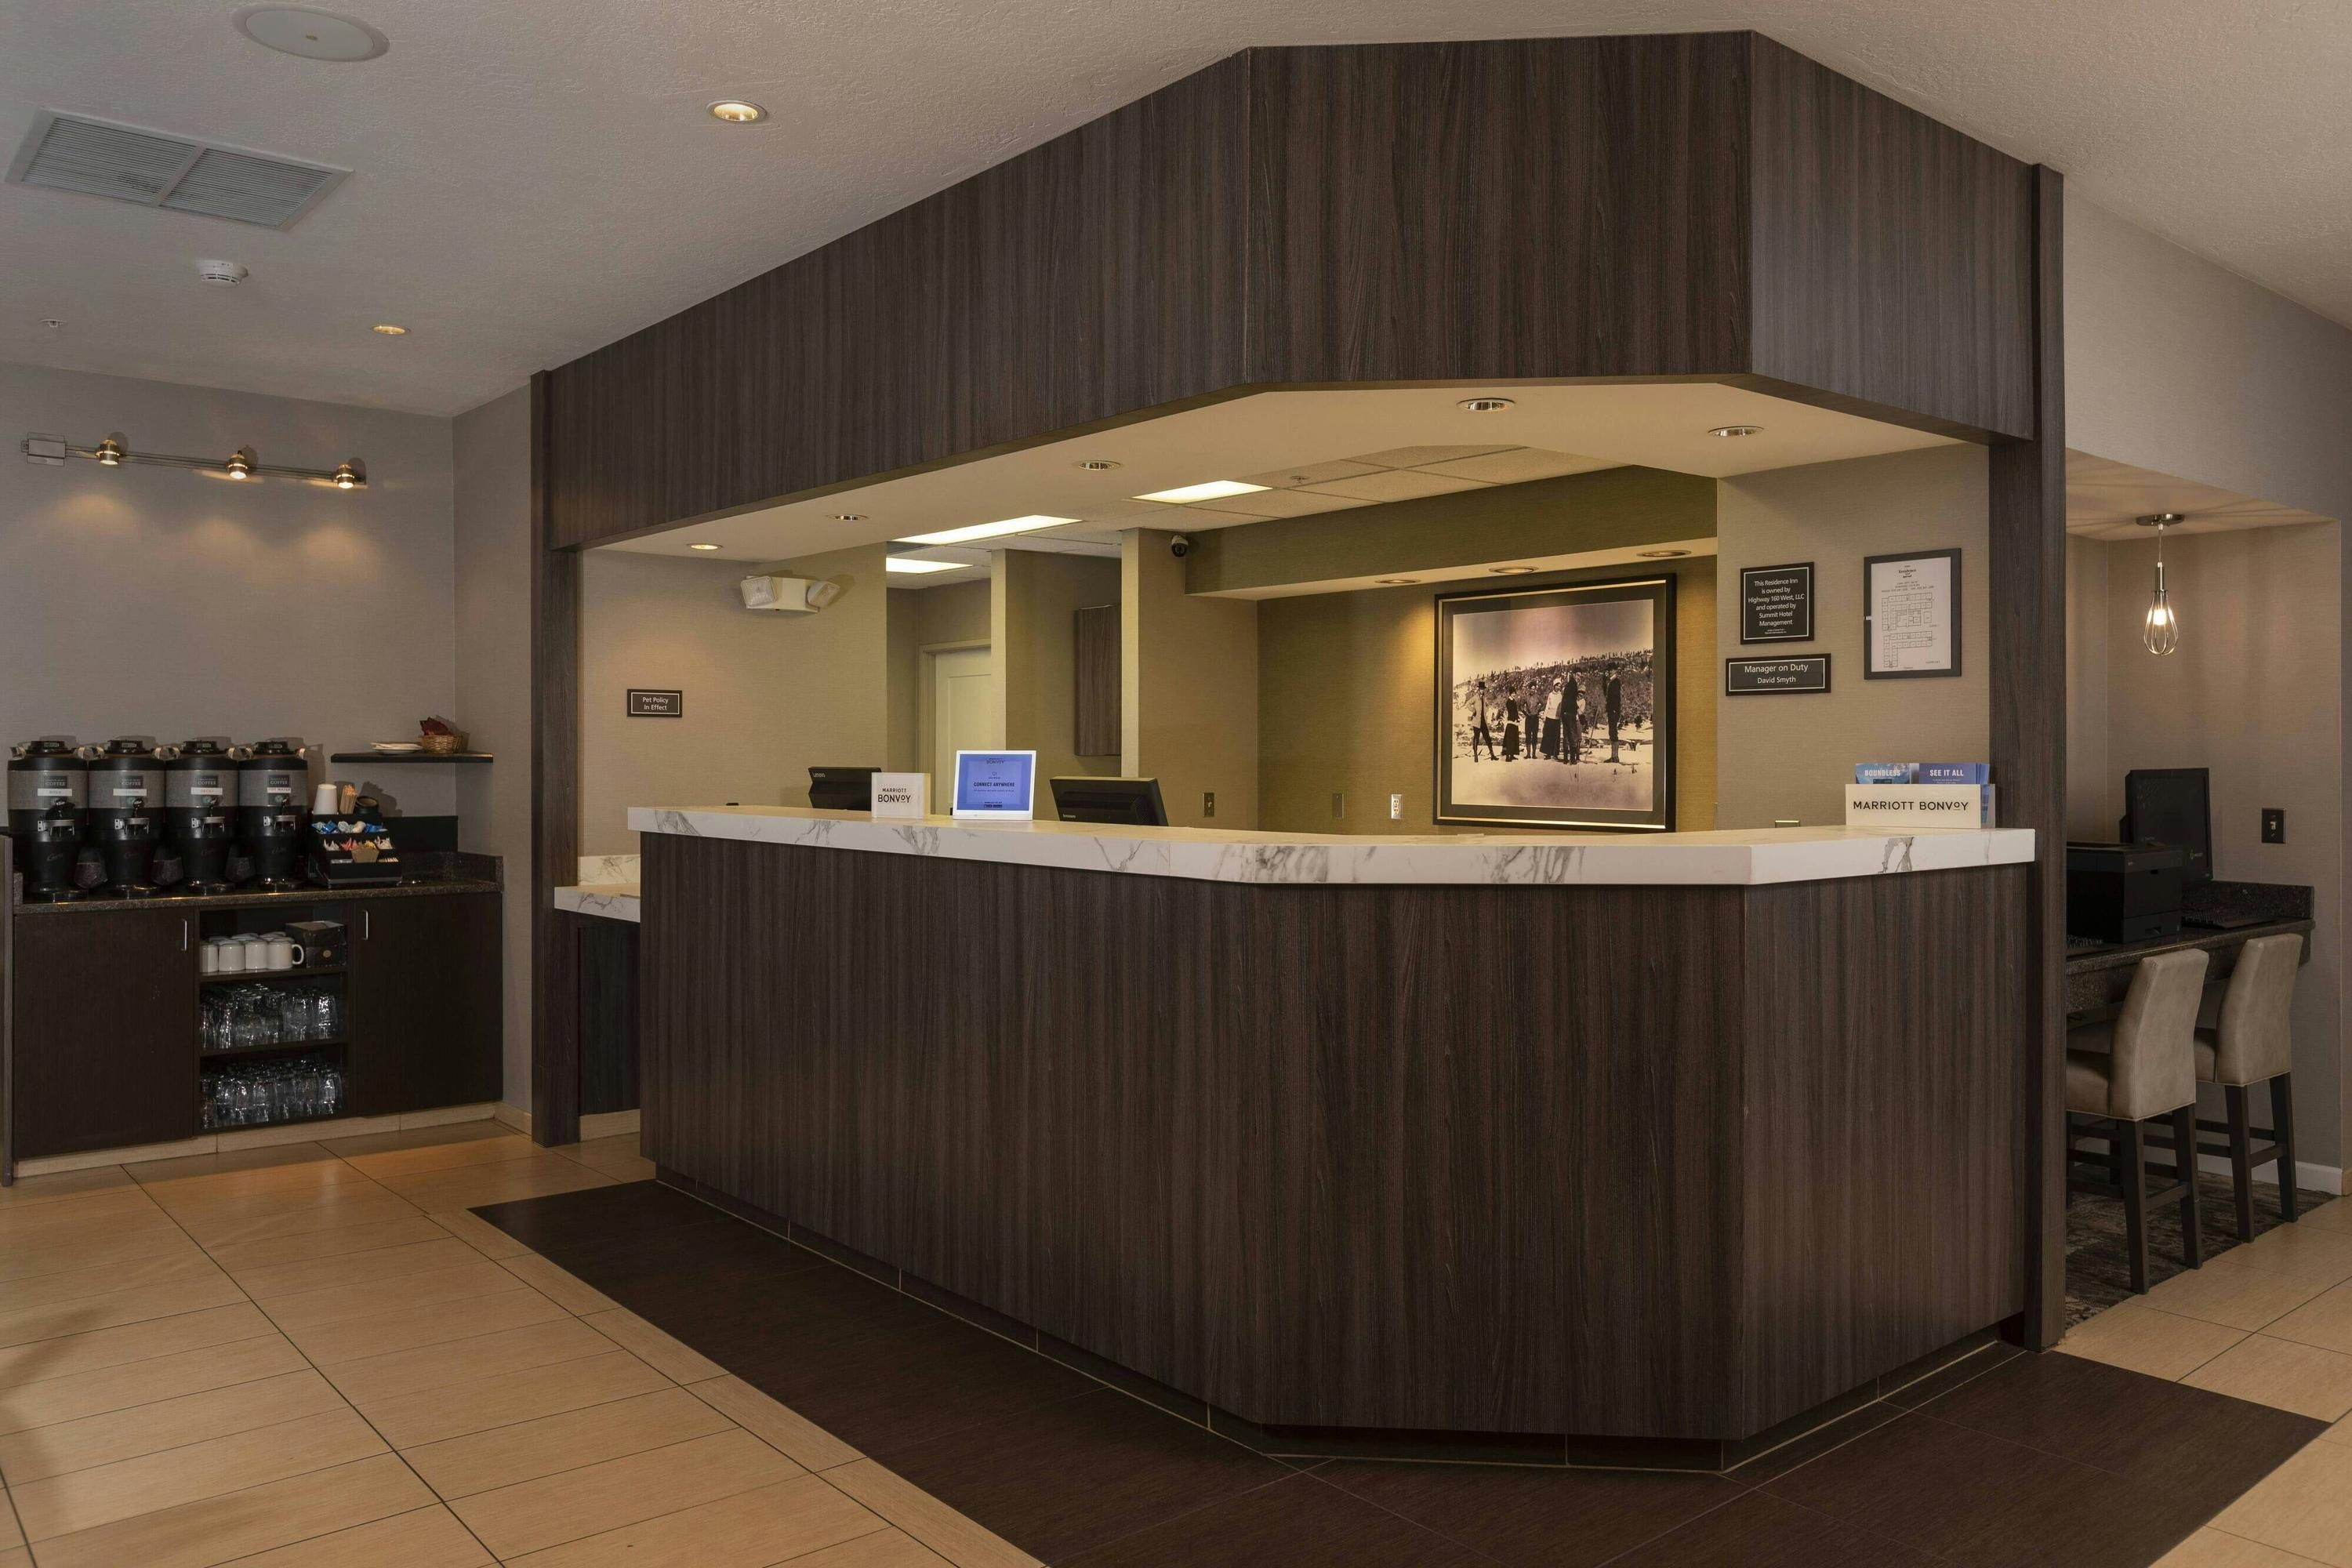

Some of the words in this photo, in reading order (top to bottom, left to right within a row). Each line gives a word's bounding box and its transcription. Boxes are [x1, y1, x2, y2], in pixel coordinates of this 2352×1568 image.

[1744, 665, 1777, 674] Manager
[1790, 663, 1809, 673] Duty
[878, 794, 911, 803] BONVOY
[1853, 801, 1915, 811] MARRIOTT
[1919, 801, 1969, 811] BONVOY
